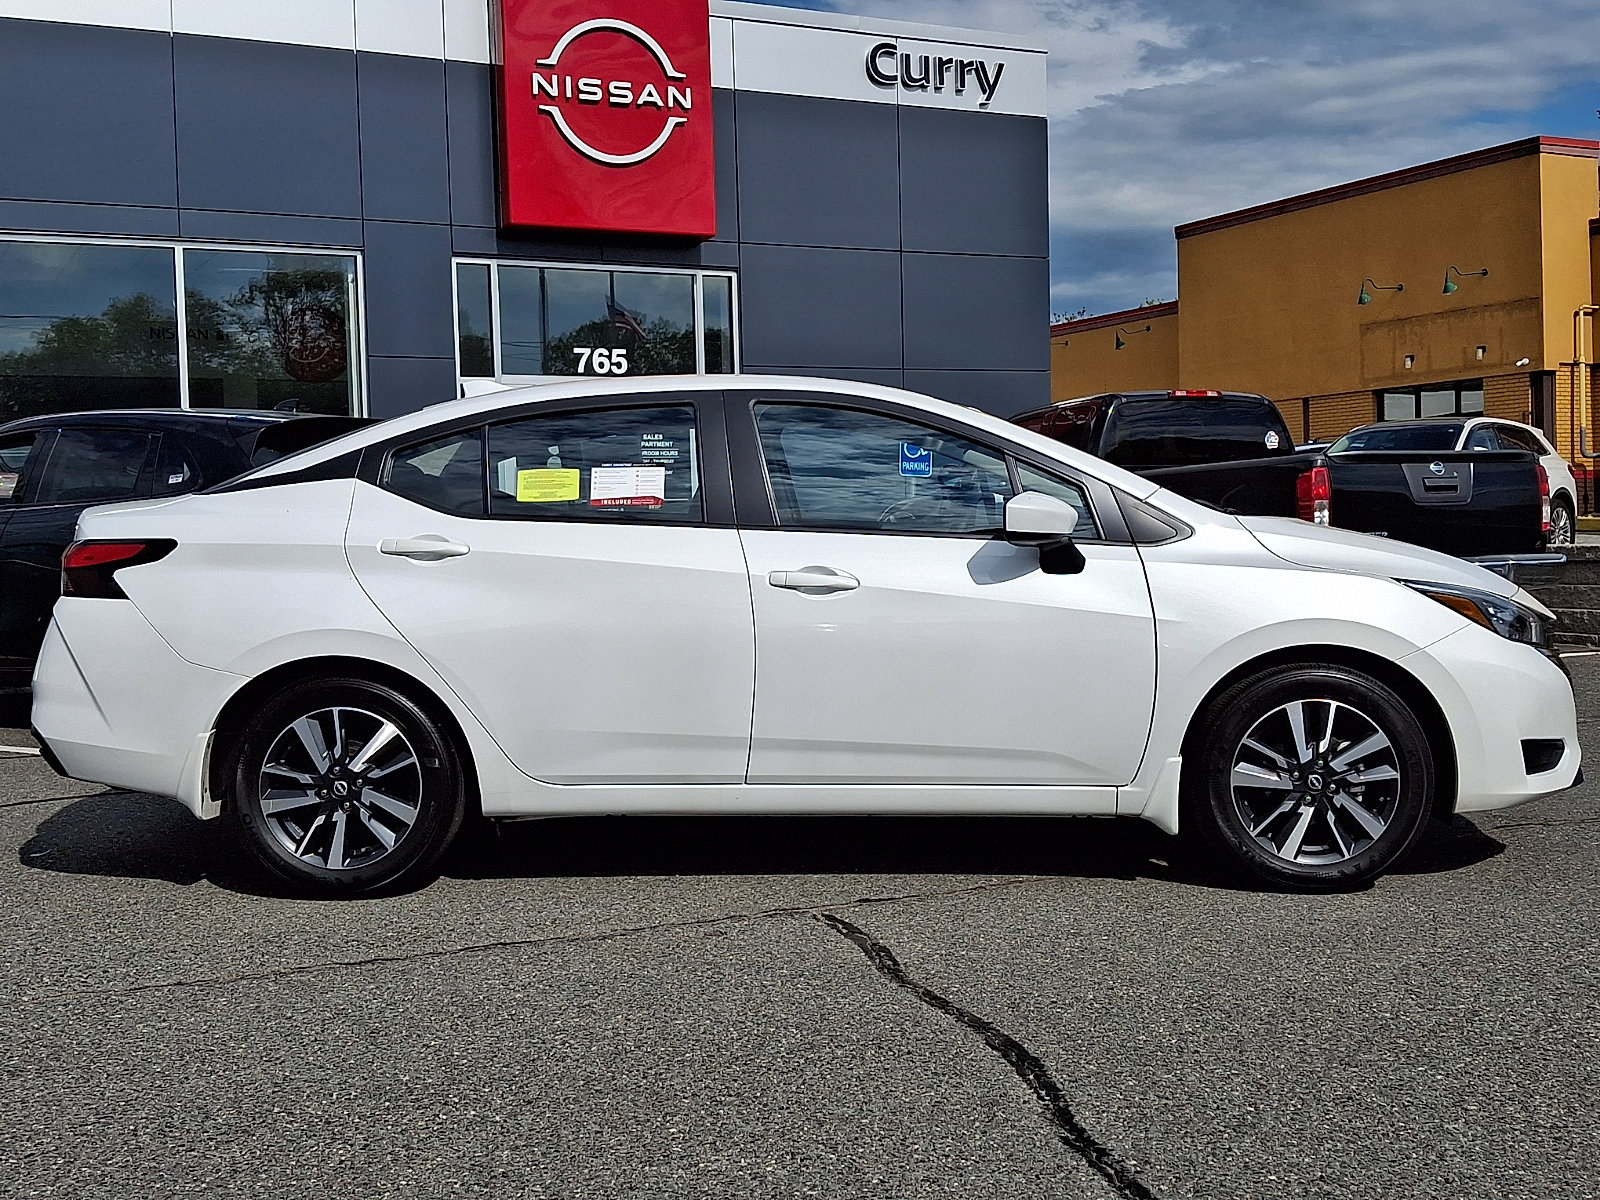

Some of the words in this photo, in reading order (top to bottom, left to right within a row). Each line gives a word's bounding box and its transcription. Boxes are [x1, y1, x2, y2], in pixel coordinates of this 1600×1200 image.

[866, 42, 1005, 106] Curry
[532, 73, 692, 109] NISSAN
[149, 326, 209, 341] NISAN
[573, 347, 628, 375] 765
[902, 461, 930, 472] PARKING
